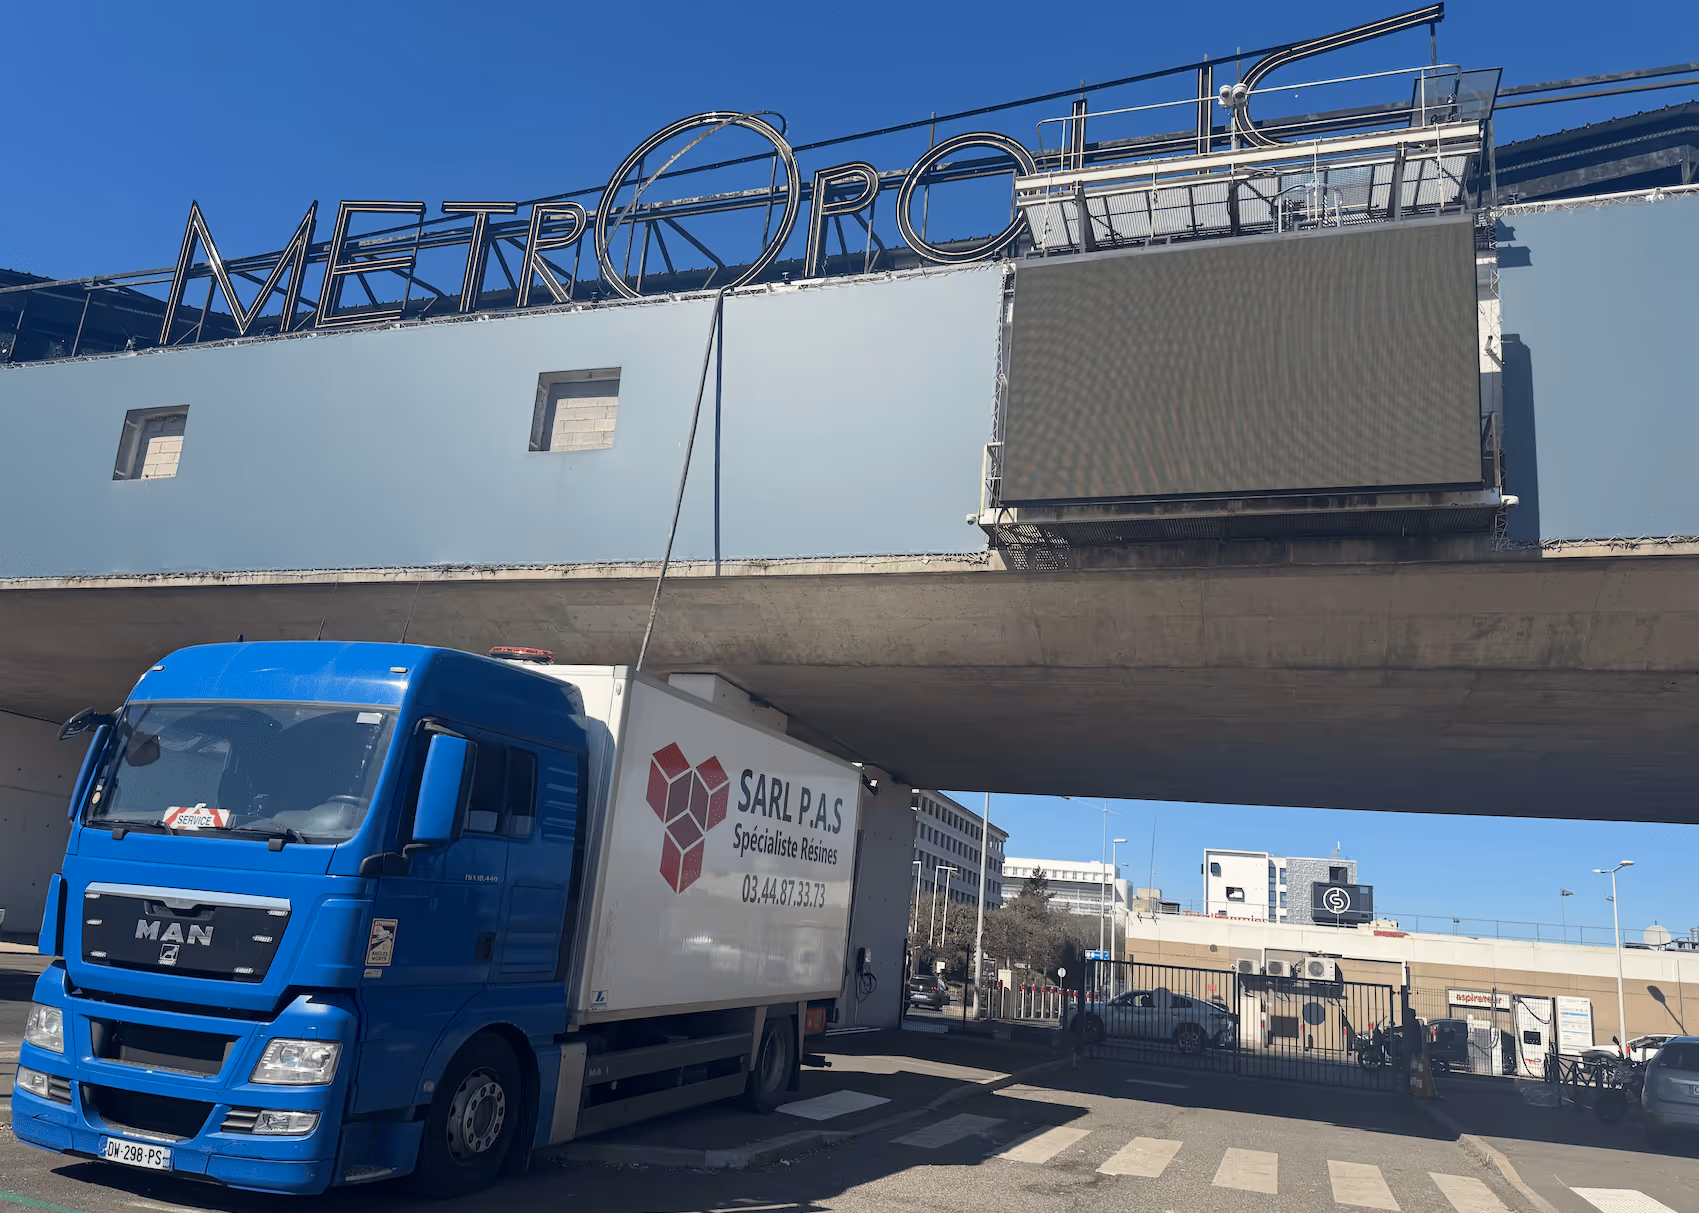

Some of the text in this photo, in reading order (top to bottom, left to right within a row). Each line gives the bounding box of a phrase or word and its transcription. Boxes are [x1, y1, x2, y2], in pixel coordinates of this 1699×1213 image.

[738, 769, 843, 834] SARL P.A.S
[177, 814, 212, 826] SERVICE
[733, 822, 837, 865] Spécialiste Résines
[742, 874, 825, 908] 03.44.87.33.73
[135, 919, 214, 946] MAN
[1456, 993, 1502, 1004] aspirater
[108, 1141, 162, 1165] DW-298-PS
